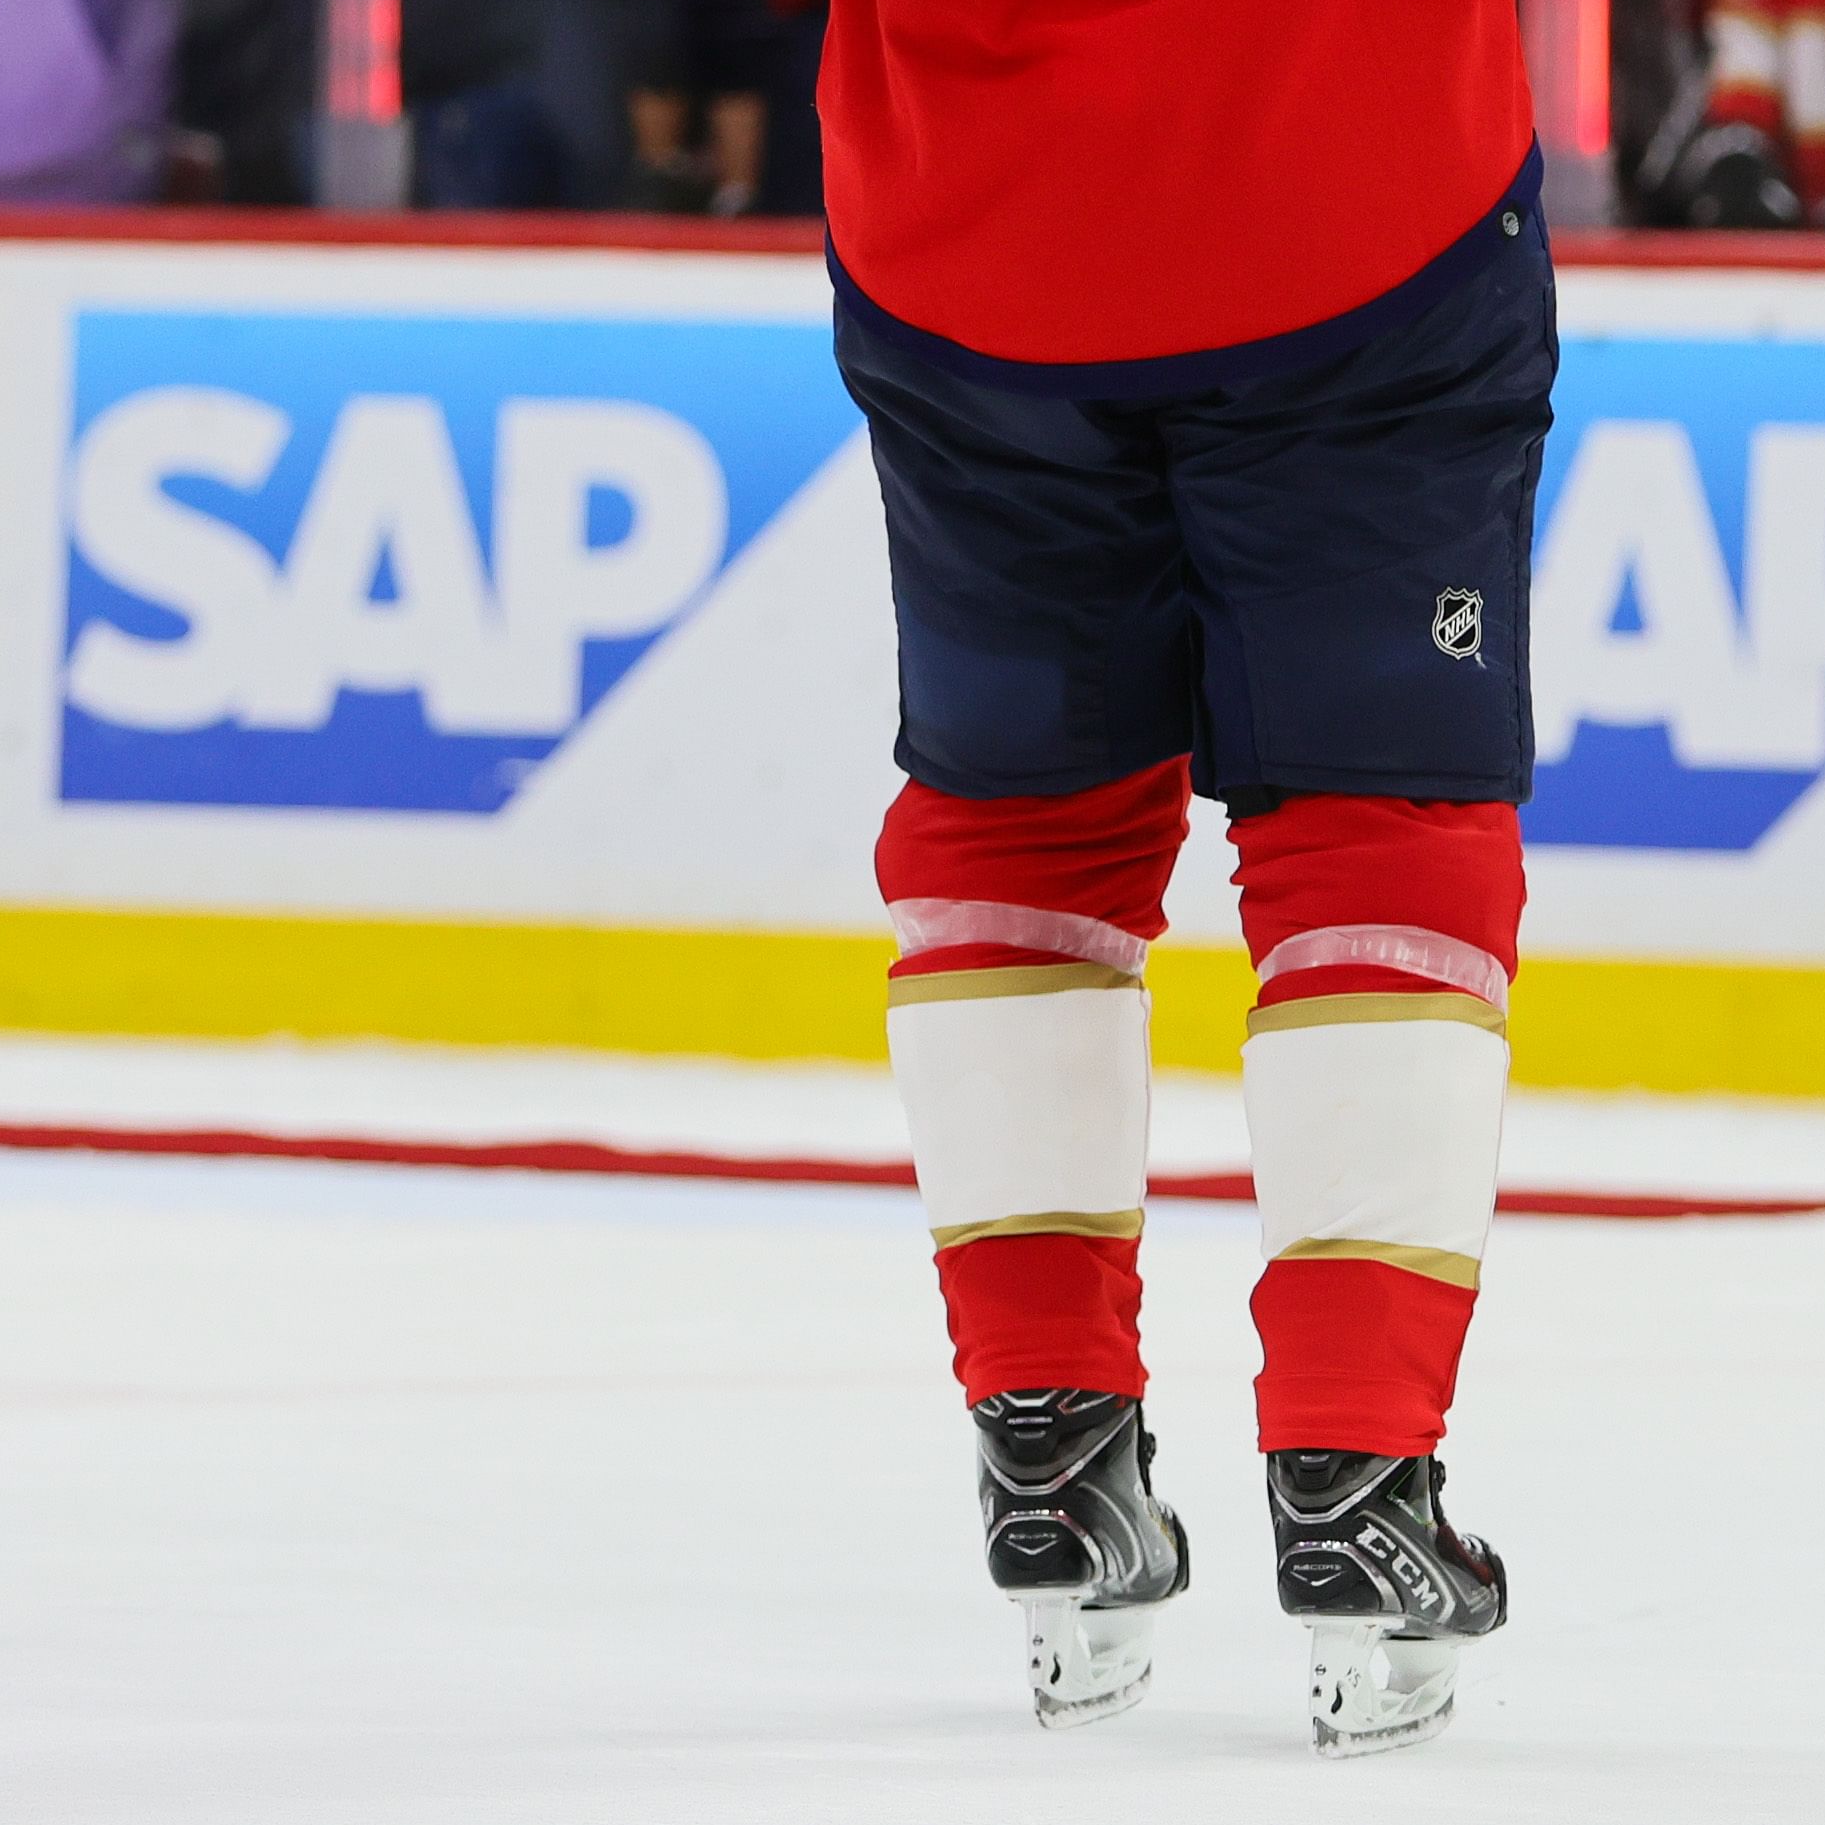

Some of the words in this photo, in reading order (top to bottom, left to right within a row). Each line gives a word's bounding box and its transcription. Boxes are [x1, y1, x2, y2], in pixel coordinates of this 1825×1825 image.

[64, 384, 730, 737] SAP
[1443, 604, 1476, 643] NHL
[1357, 1522, 1440, 1611] CCM
